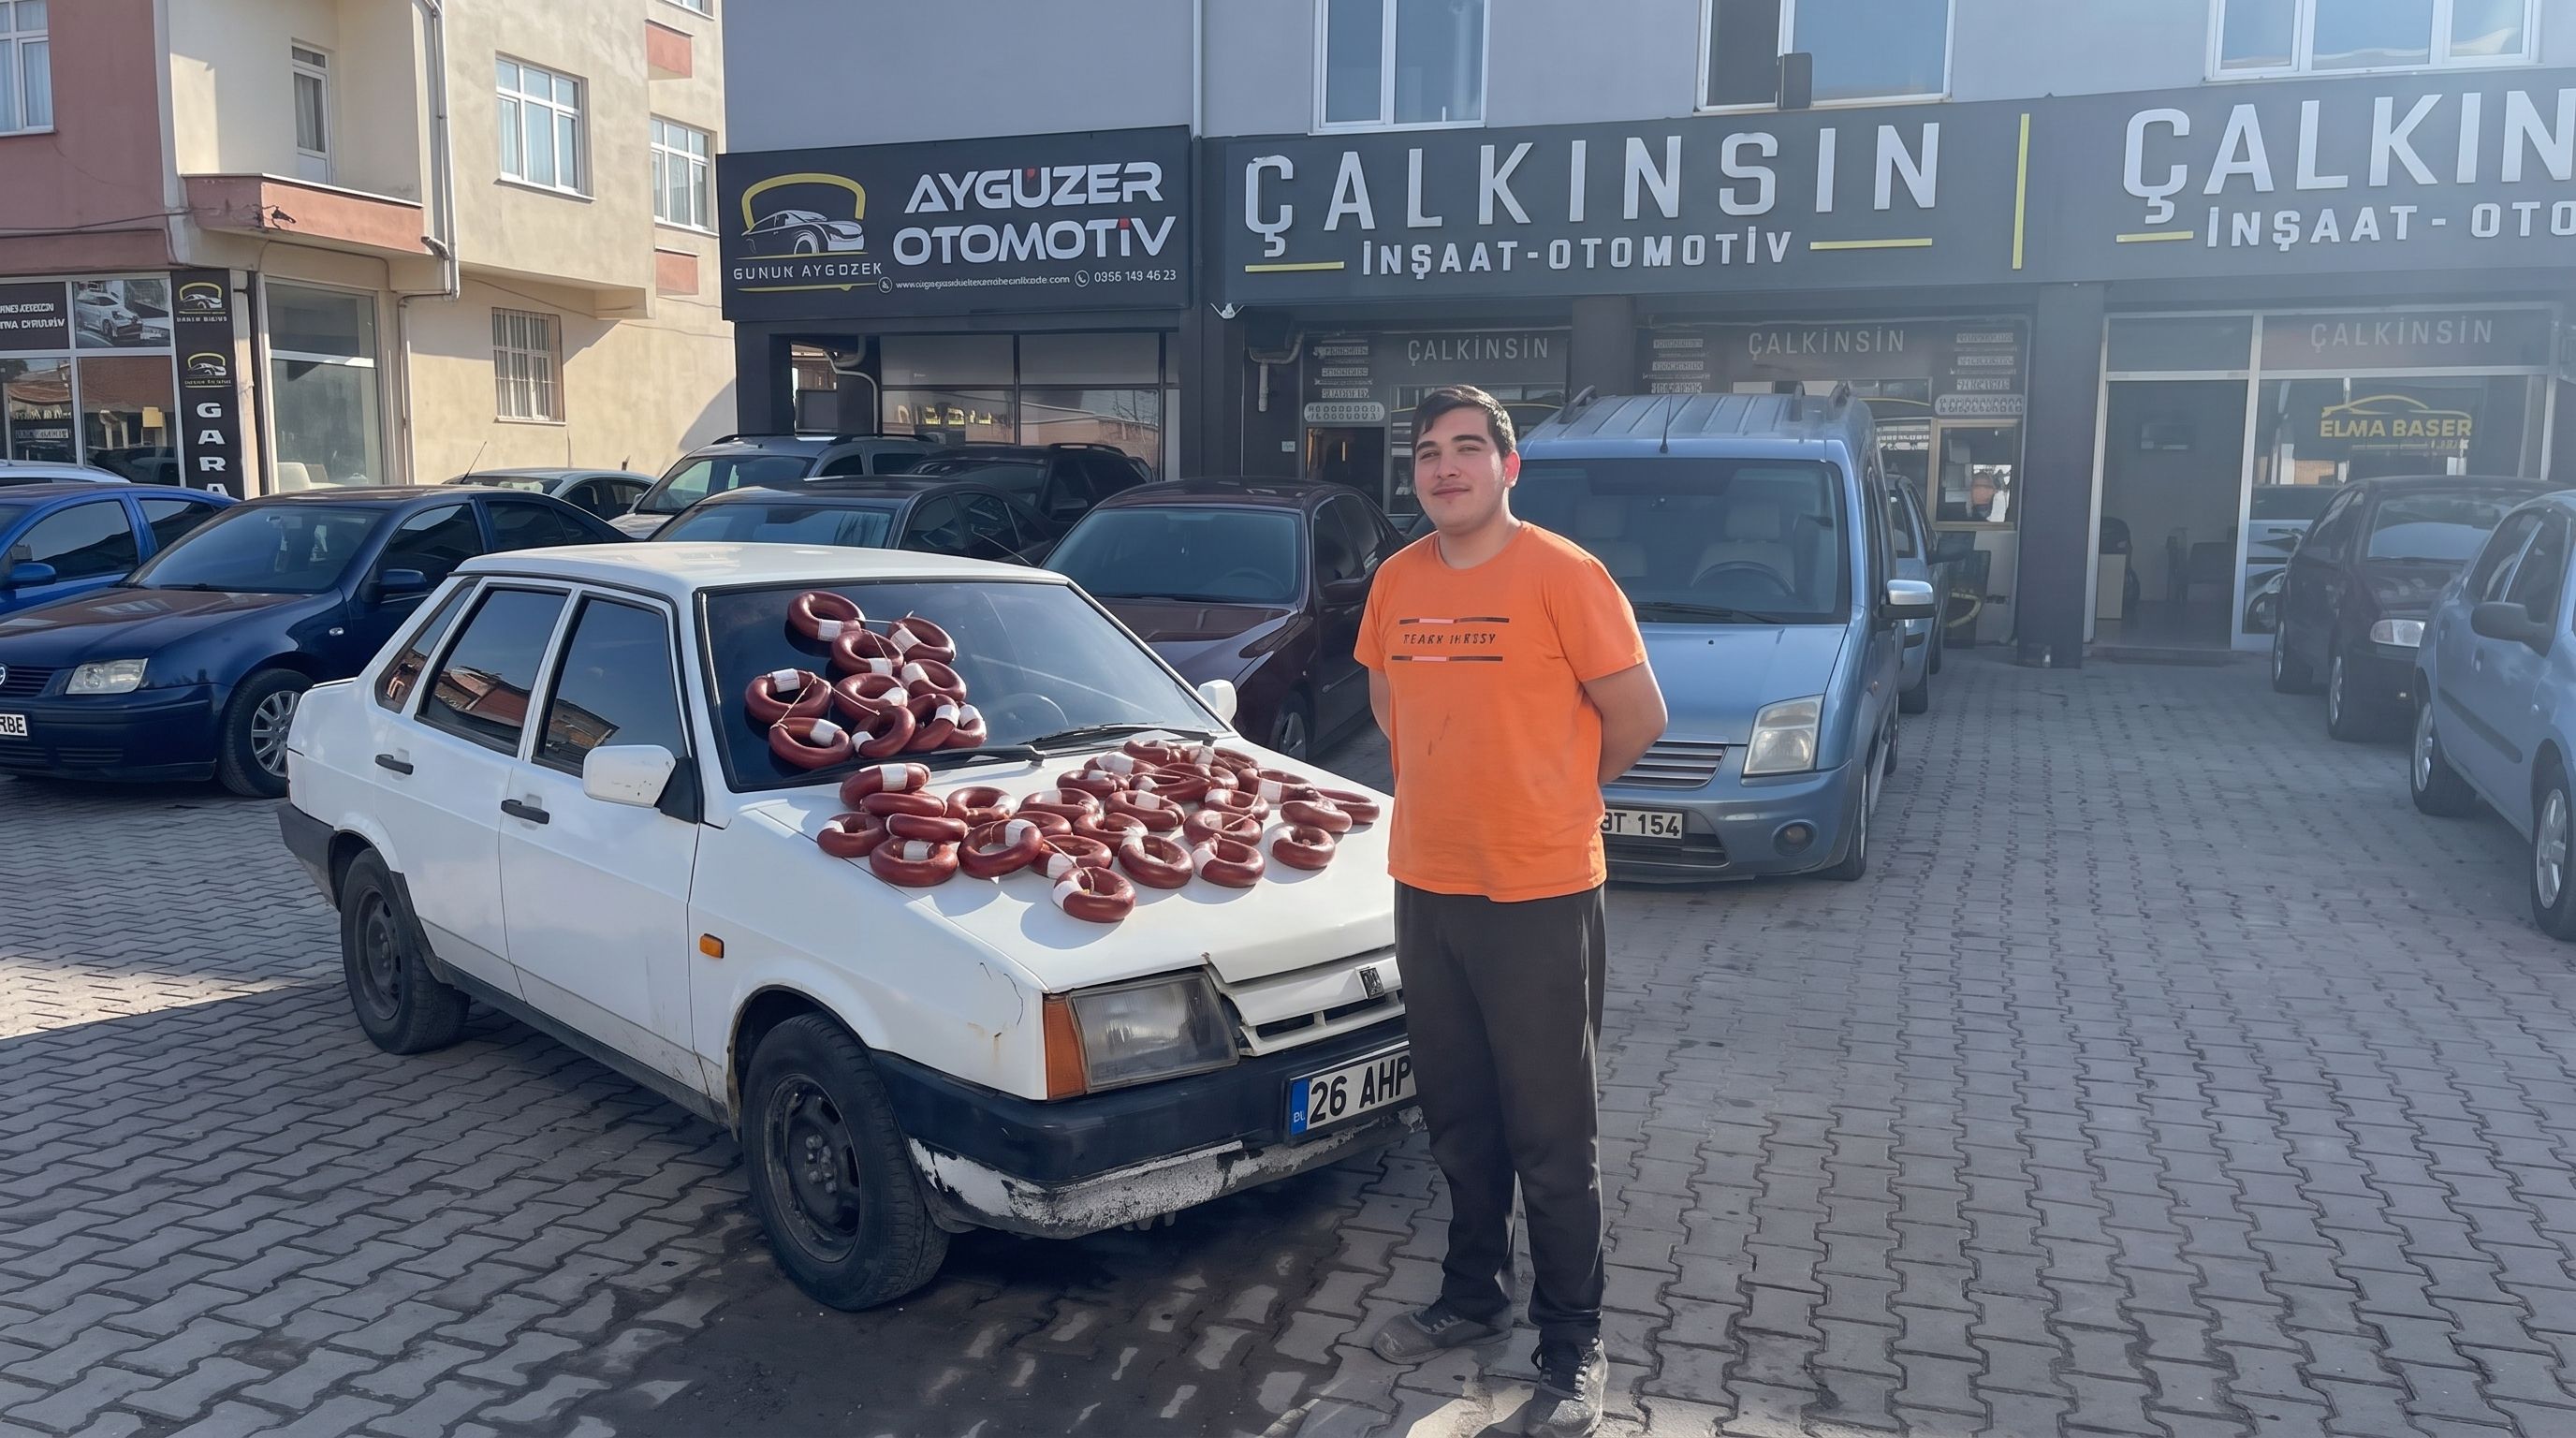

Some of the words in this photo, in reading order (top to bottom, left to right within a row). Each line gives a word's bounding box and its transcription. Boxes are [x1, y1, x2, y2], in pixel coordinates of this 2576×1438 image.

[1245, 122, 1940, 257] ÇALKINSIN
[1147, 270, 1161, 281] 46
[1164, 270, 1177, 281] 23
[2320, 419, 2386, 437] ELMA
[2393, 418, 2473, 437] BASER
[1638, 814, 1679, 837] 154
[1310, 1075, 1348, 1125] 26
[1359, 1054, 1412, 1109] AHP
